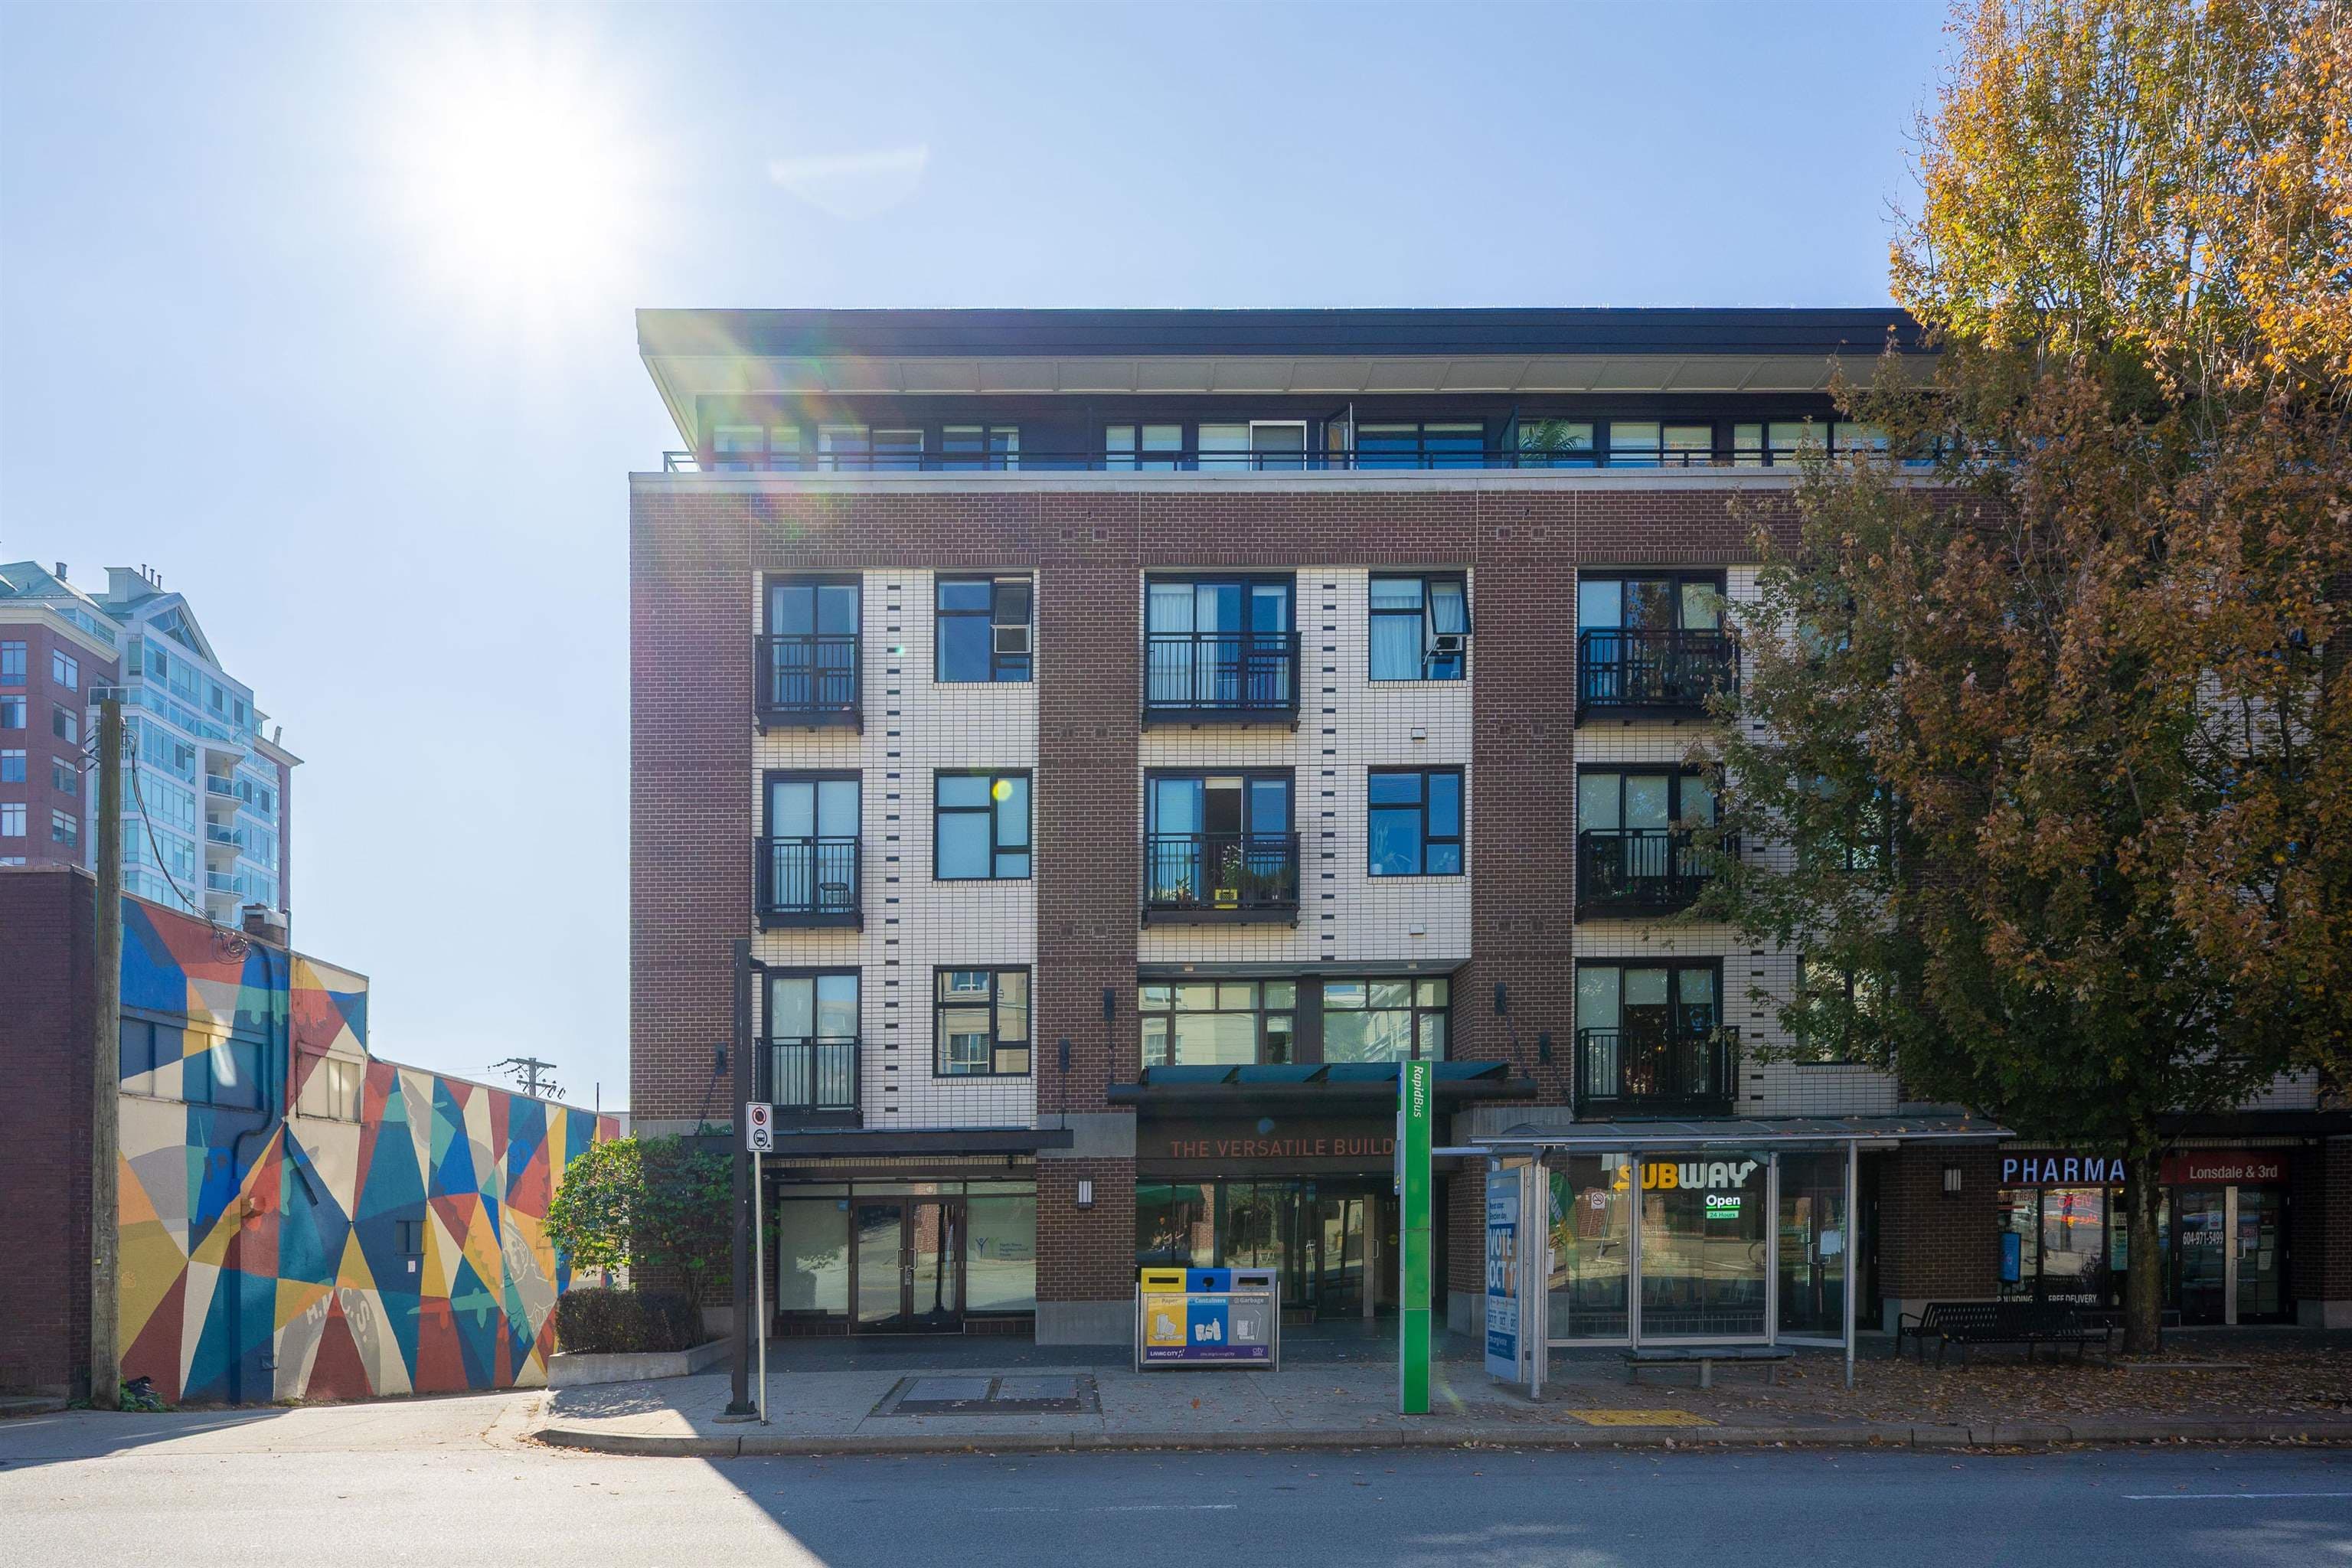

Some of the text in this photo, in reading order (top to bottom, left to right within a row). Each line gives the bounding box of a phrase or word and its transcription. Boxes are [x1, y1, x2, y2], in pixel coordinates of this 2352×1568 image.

[1411, 1065, 1424, 1118] RapidBus
[1171, 1141, 1210, 1158] THE
[1217, 1139, 1326, 1157] VERSATILE
[1612, 1158, 1758, 1191] SUBWAY
[2003, 1157, 2125, 1183] PHARMA
[2190, 1165, 2278, 1179] Lonsdale & 3rd
[1706, 1194, 1740, 1209] Open
[2057, 1194, 2092, 1208] OPEN
[1489, 1227, 1511, 1256] VOTE
[2183, 1230, 2224, 1246] 604-971-5499
[1489, 1260, 1507, 1288] OCT
[2048, 1294, 2065, 1303] FREE
[2066, 1294, 2098, 1304] DELIVERY
